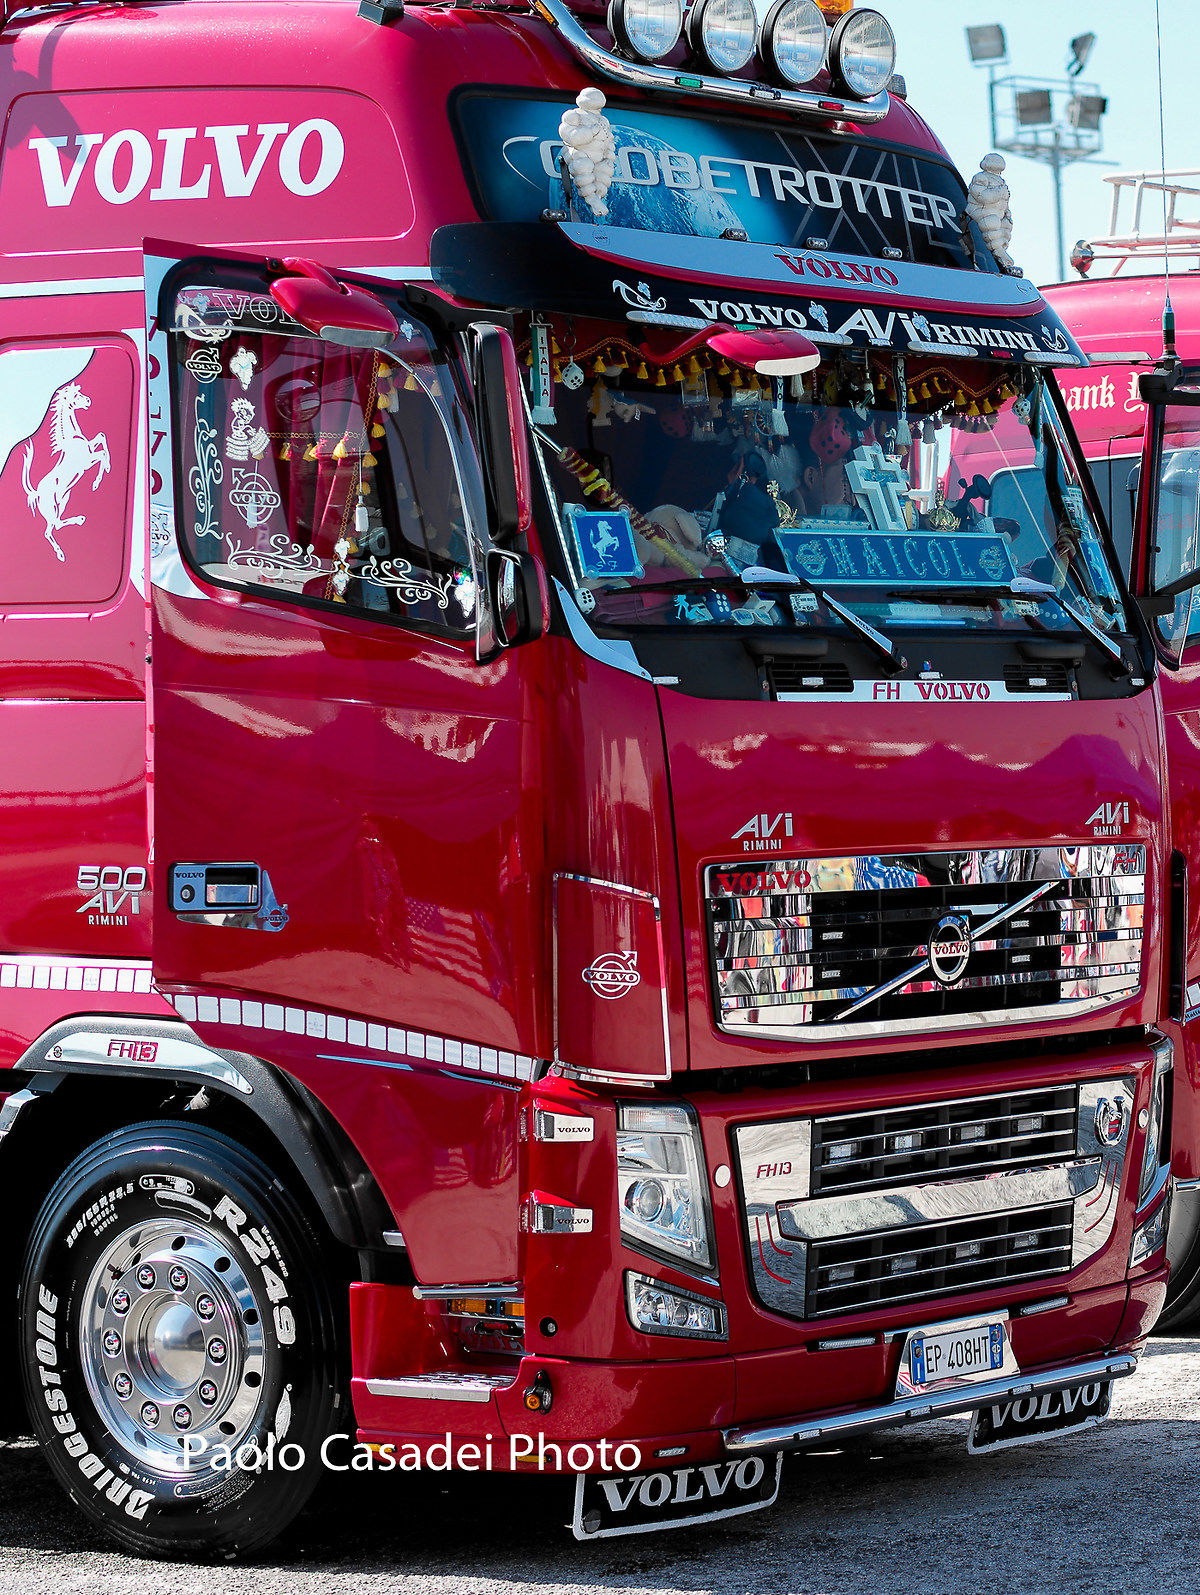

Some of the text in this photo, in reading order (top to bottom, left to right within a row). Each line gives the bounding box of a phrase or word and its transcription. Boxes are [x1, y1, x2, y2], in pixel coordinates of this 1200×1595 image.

[28, 118, 344, 207] VOLVO
[540, 140, 963, 234] GOBETROTTER
[774, 253, 899, 286] VOLVO
[688, 298, 808, 328] VOLVO
[930, 323, 1042, 352] RIMINI
[539, 336, 550, 397] ITALIA
[233, 493, 277, 504] VOLVO
[824, 537, 977, 579] MAICOL
[853, 616, 875, 635] VOLVO
[873, 682, 991, 700] FH VOLVO
[1093, 825, 1122, 836] RIMINI
[743, 839, 783, 851] RIMINI
[76, 866, 147, 891] 500
[716, 870, 812, 892] VOLVO
[88, 914, 128, 925] RIMINI
[932, 943, 967, 955] VOLVO
[586, 970, 640, 982] VOLVO
[756, 1160, 793, 1178] FH13
[925, 1344, 942, 1374] EP
[947, 1335, 989, 1370] 408HT
[35, 1283, 156, 1521] BRIDGESTONE
[991, 1380, 1100, 1429] VOLVO
[597, 1455, 765, 1512] VOLVO
